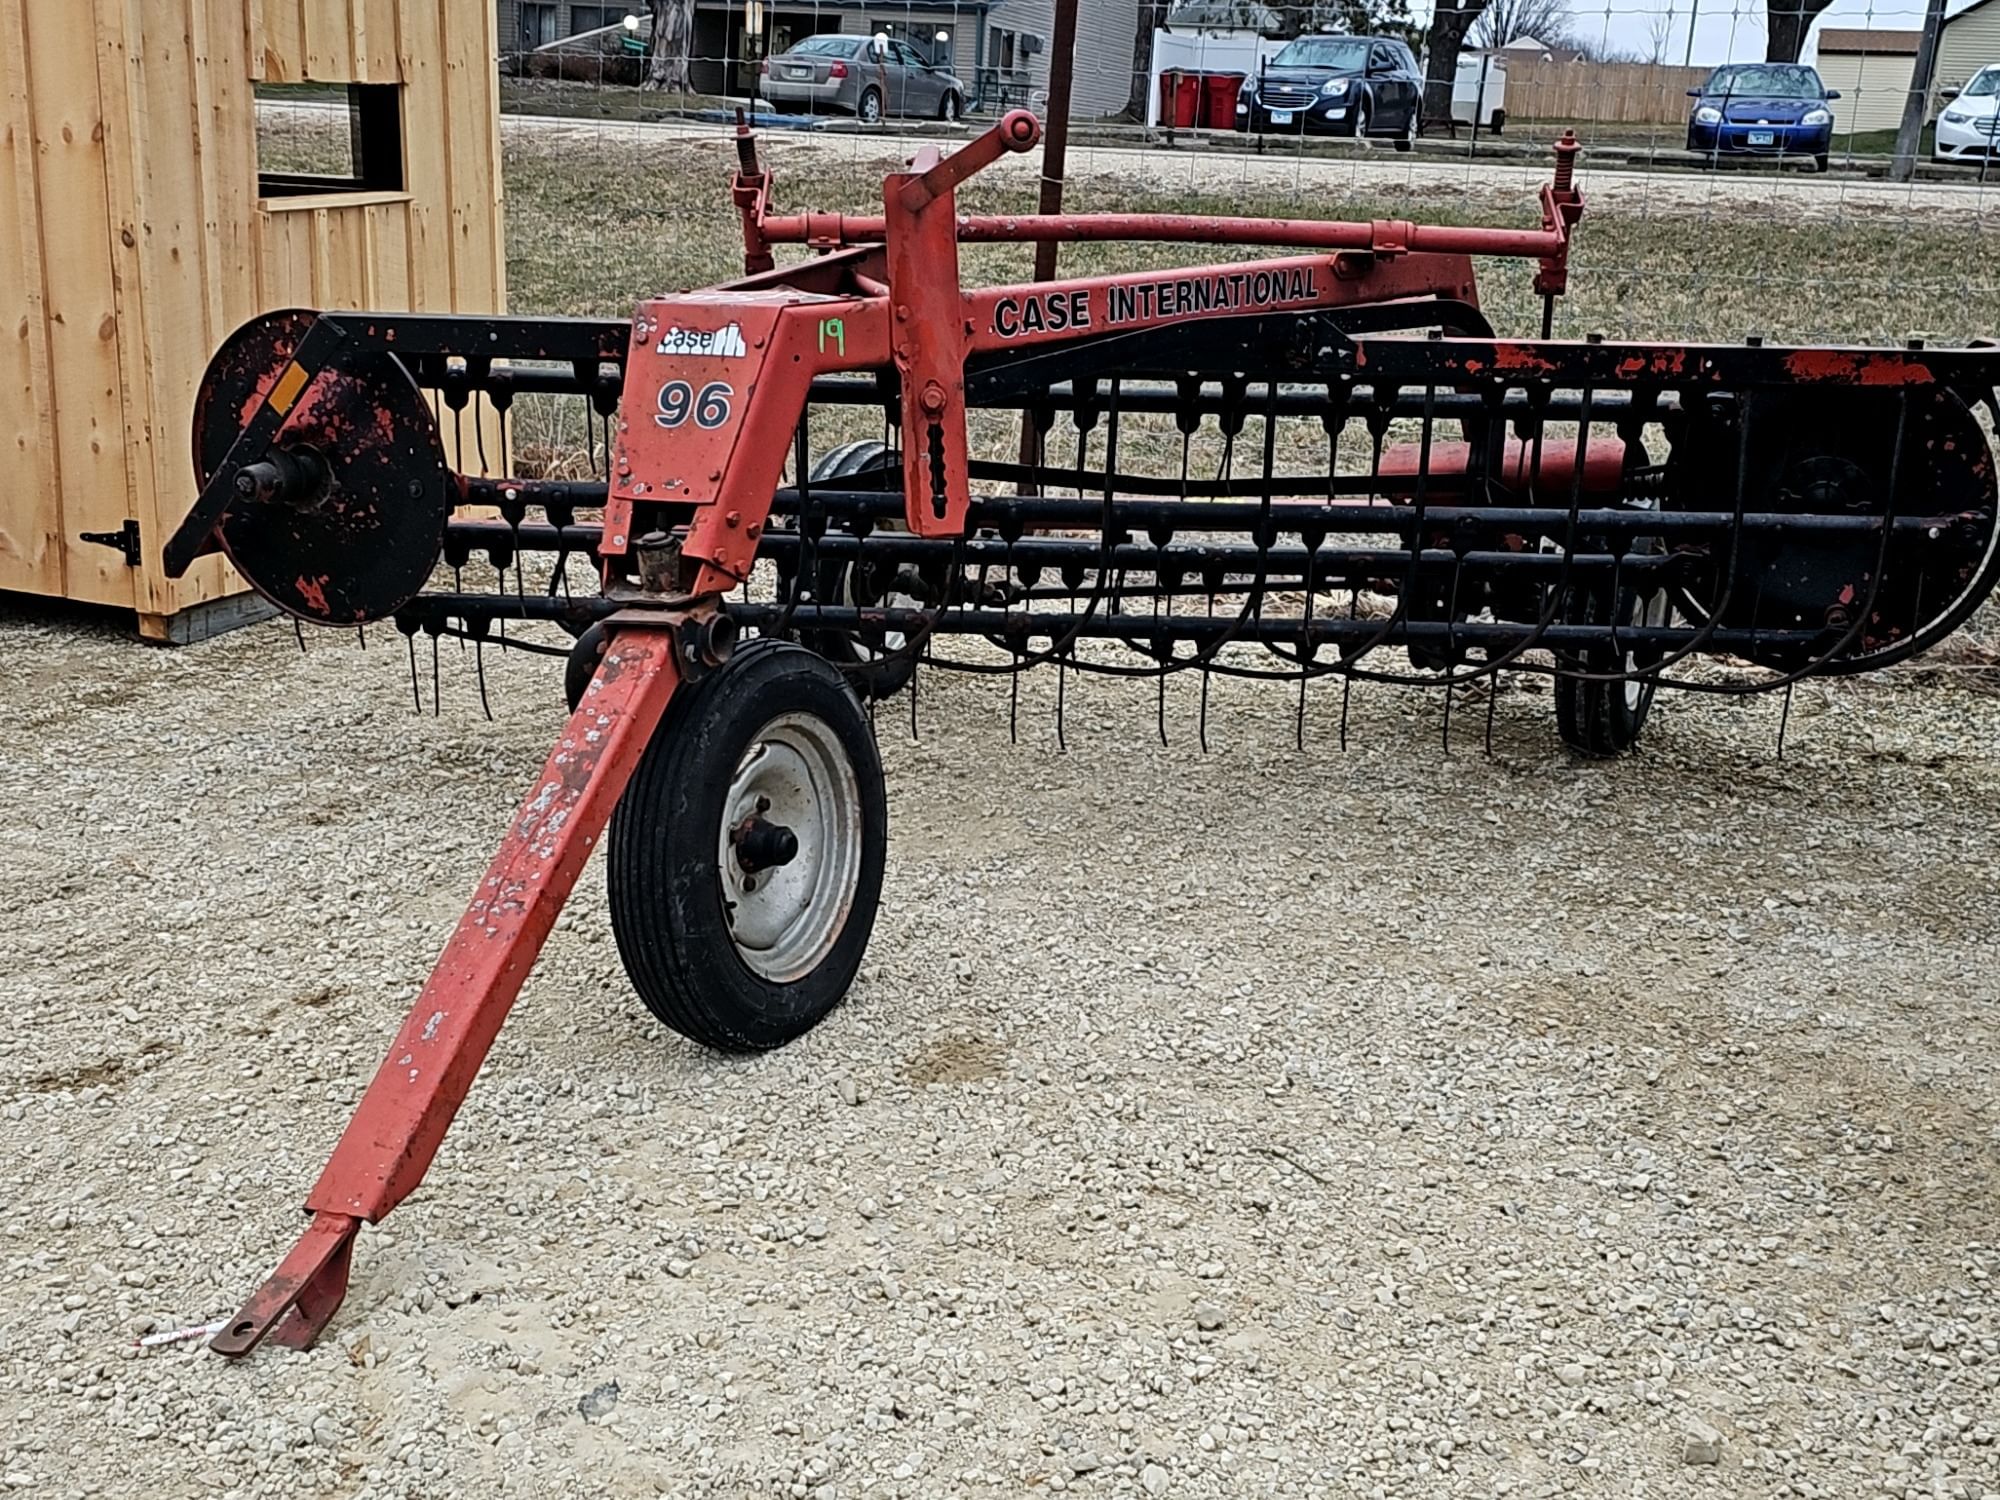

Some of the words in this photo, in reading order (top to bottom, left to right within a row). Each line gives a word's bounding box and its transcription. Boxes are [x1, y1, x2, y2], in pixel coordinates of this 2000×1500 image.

[994, 289, 1090, 338] CASE
[1108, 267, 1319, 324] INTERNATIONAL
[818, 318, 845, 357] 19
[654, 379, 735, 430] 96
